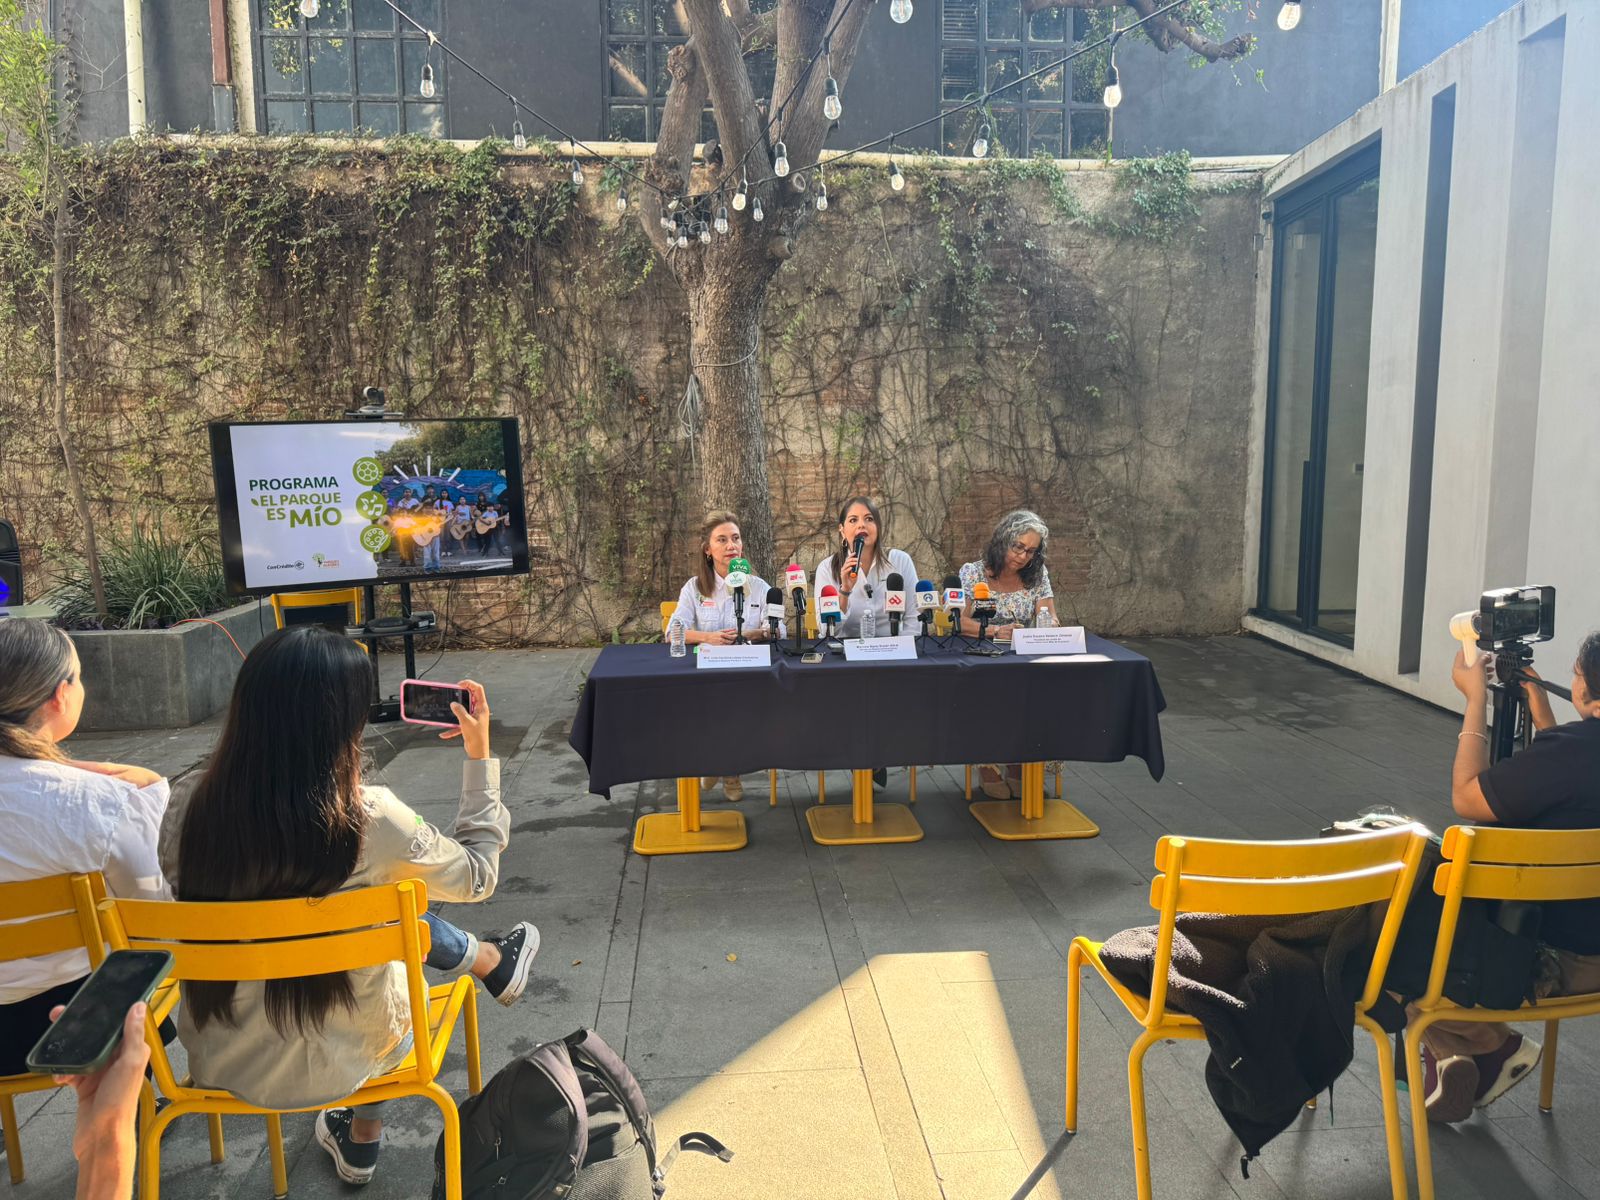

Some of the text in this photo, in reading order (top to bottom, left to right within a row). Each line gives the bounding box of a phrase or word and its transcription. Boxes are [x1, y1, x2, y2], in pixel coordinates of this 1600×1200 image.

[249, 476, 339, 491] PROGRAMA
[260, 492, 341, 507] EL PARQUE
[267, 507, 286, 521] ES
